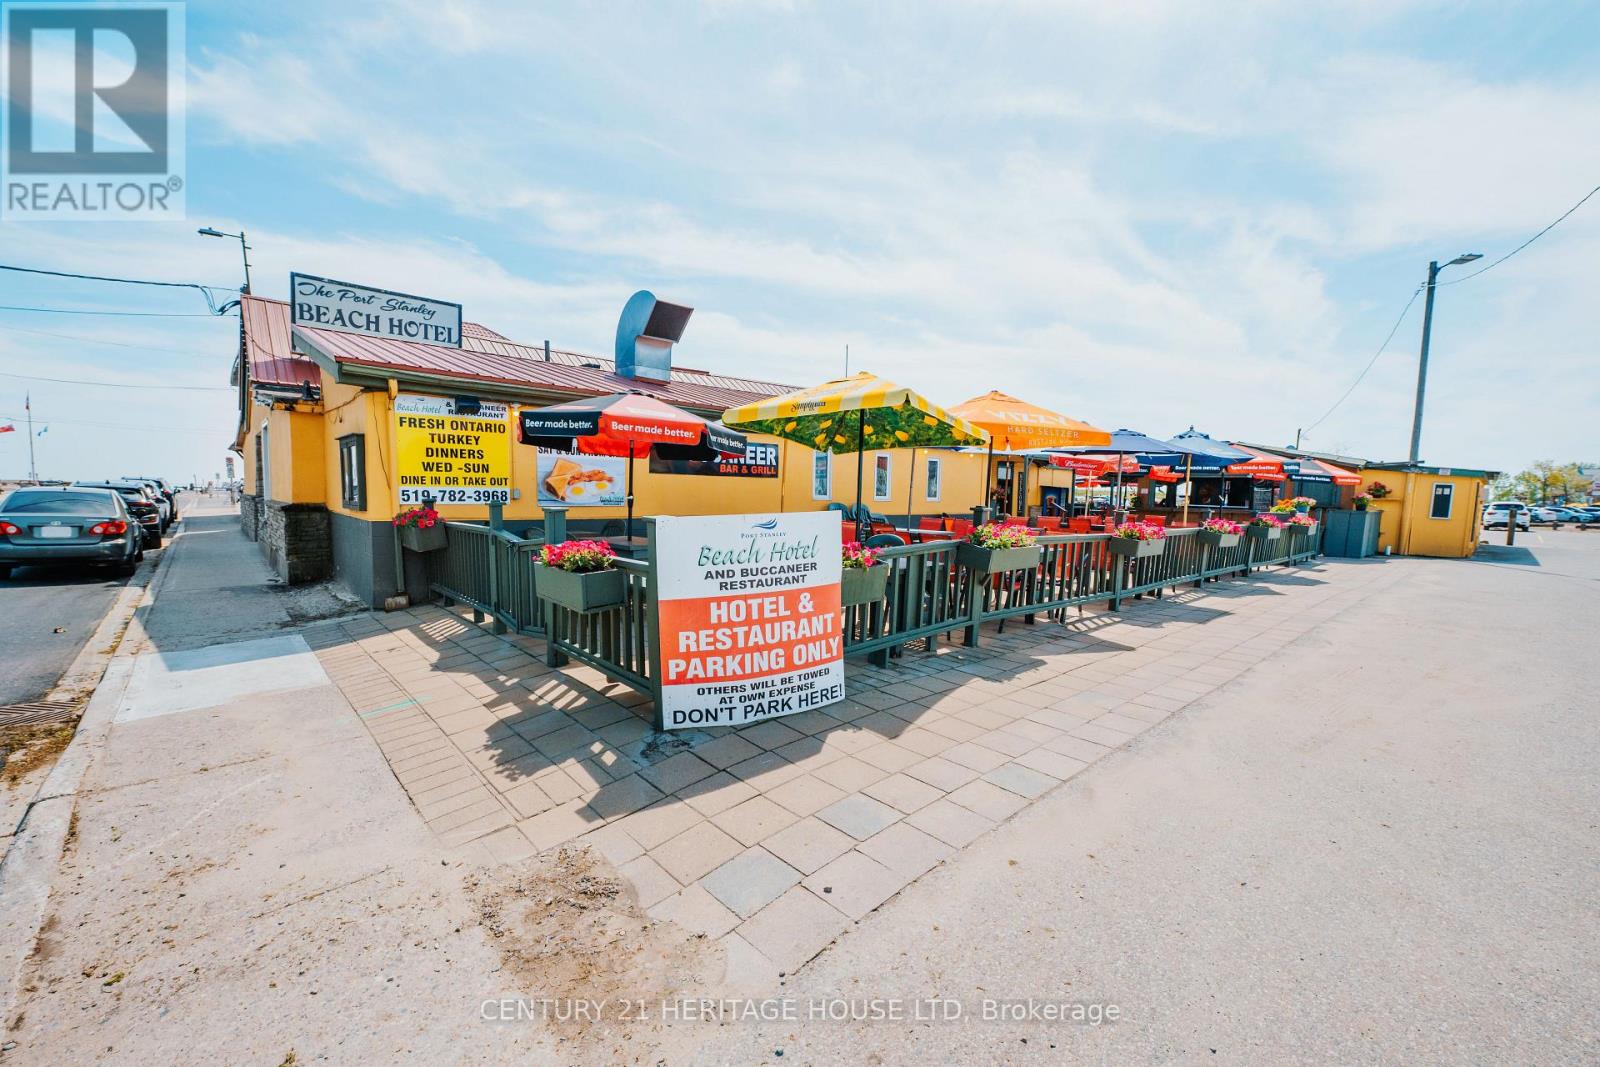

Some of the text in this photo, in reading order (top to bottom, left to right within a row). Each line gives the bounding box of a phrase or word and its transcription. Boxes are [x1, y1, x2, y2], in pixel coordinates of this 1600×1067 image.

[297, 281, 437, 321] The Port Stanley
[297, 302, 459, 345] BEACH HOTEL
[396, 402, 420, 413] Beach
[421, 405, 443, 415] Hotel
[399, 416, 506, 434] FRESH ONTARIO
[525, 418, 593, 429] Beer made better.
[610, 421, 696, 438] Beer made better.
[1007, 424, 1080, 438] HARD SELTZER
[428, 432, 481, 446] TURKEY
[425, 447, 485, 460] DINNERS
[421, 461, 453, 473] WED
[719, 464, 777, 475] BAR & GRILL
[400, 475, 509, 486] DINE IN OR TAKE OUT
[401, 489, 508, 503] 519-782-3968
[697, 534, 819, 567] Beach Hotel
[704, 562, 818, 580] AND BUCCANEER
[719, 574, 807, 591] RESTAURANT
[710, 591, 815, 625] HOTEL &
[678, 612, 834, 653] RESTAURANT
[668, 636, 841, 681] PARKING ONLY
[696, 667, 830, 696] OTHERS WILL BE TOWED
[718, 681, 816, 705] AT OWN EXPENSE
[672, 683, 843, 725] DON'T PARK HERE!
